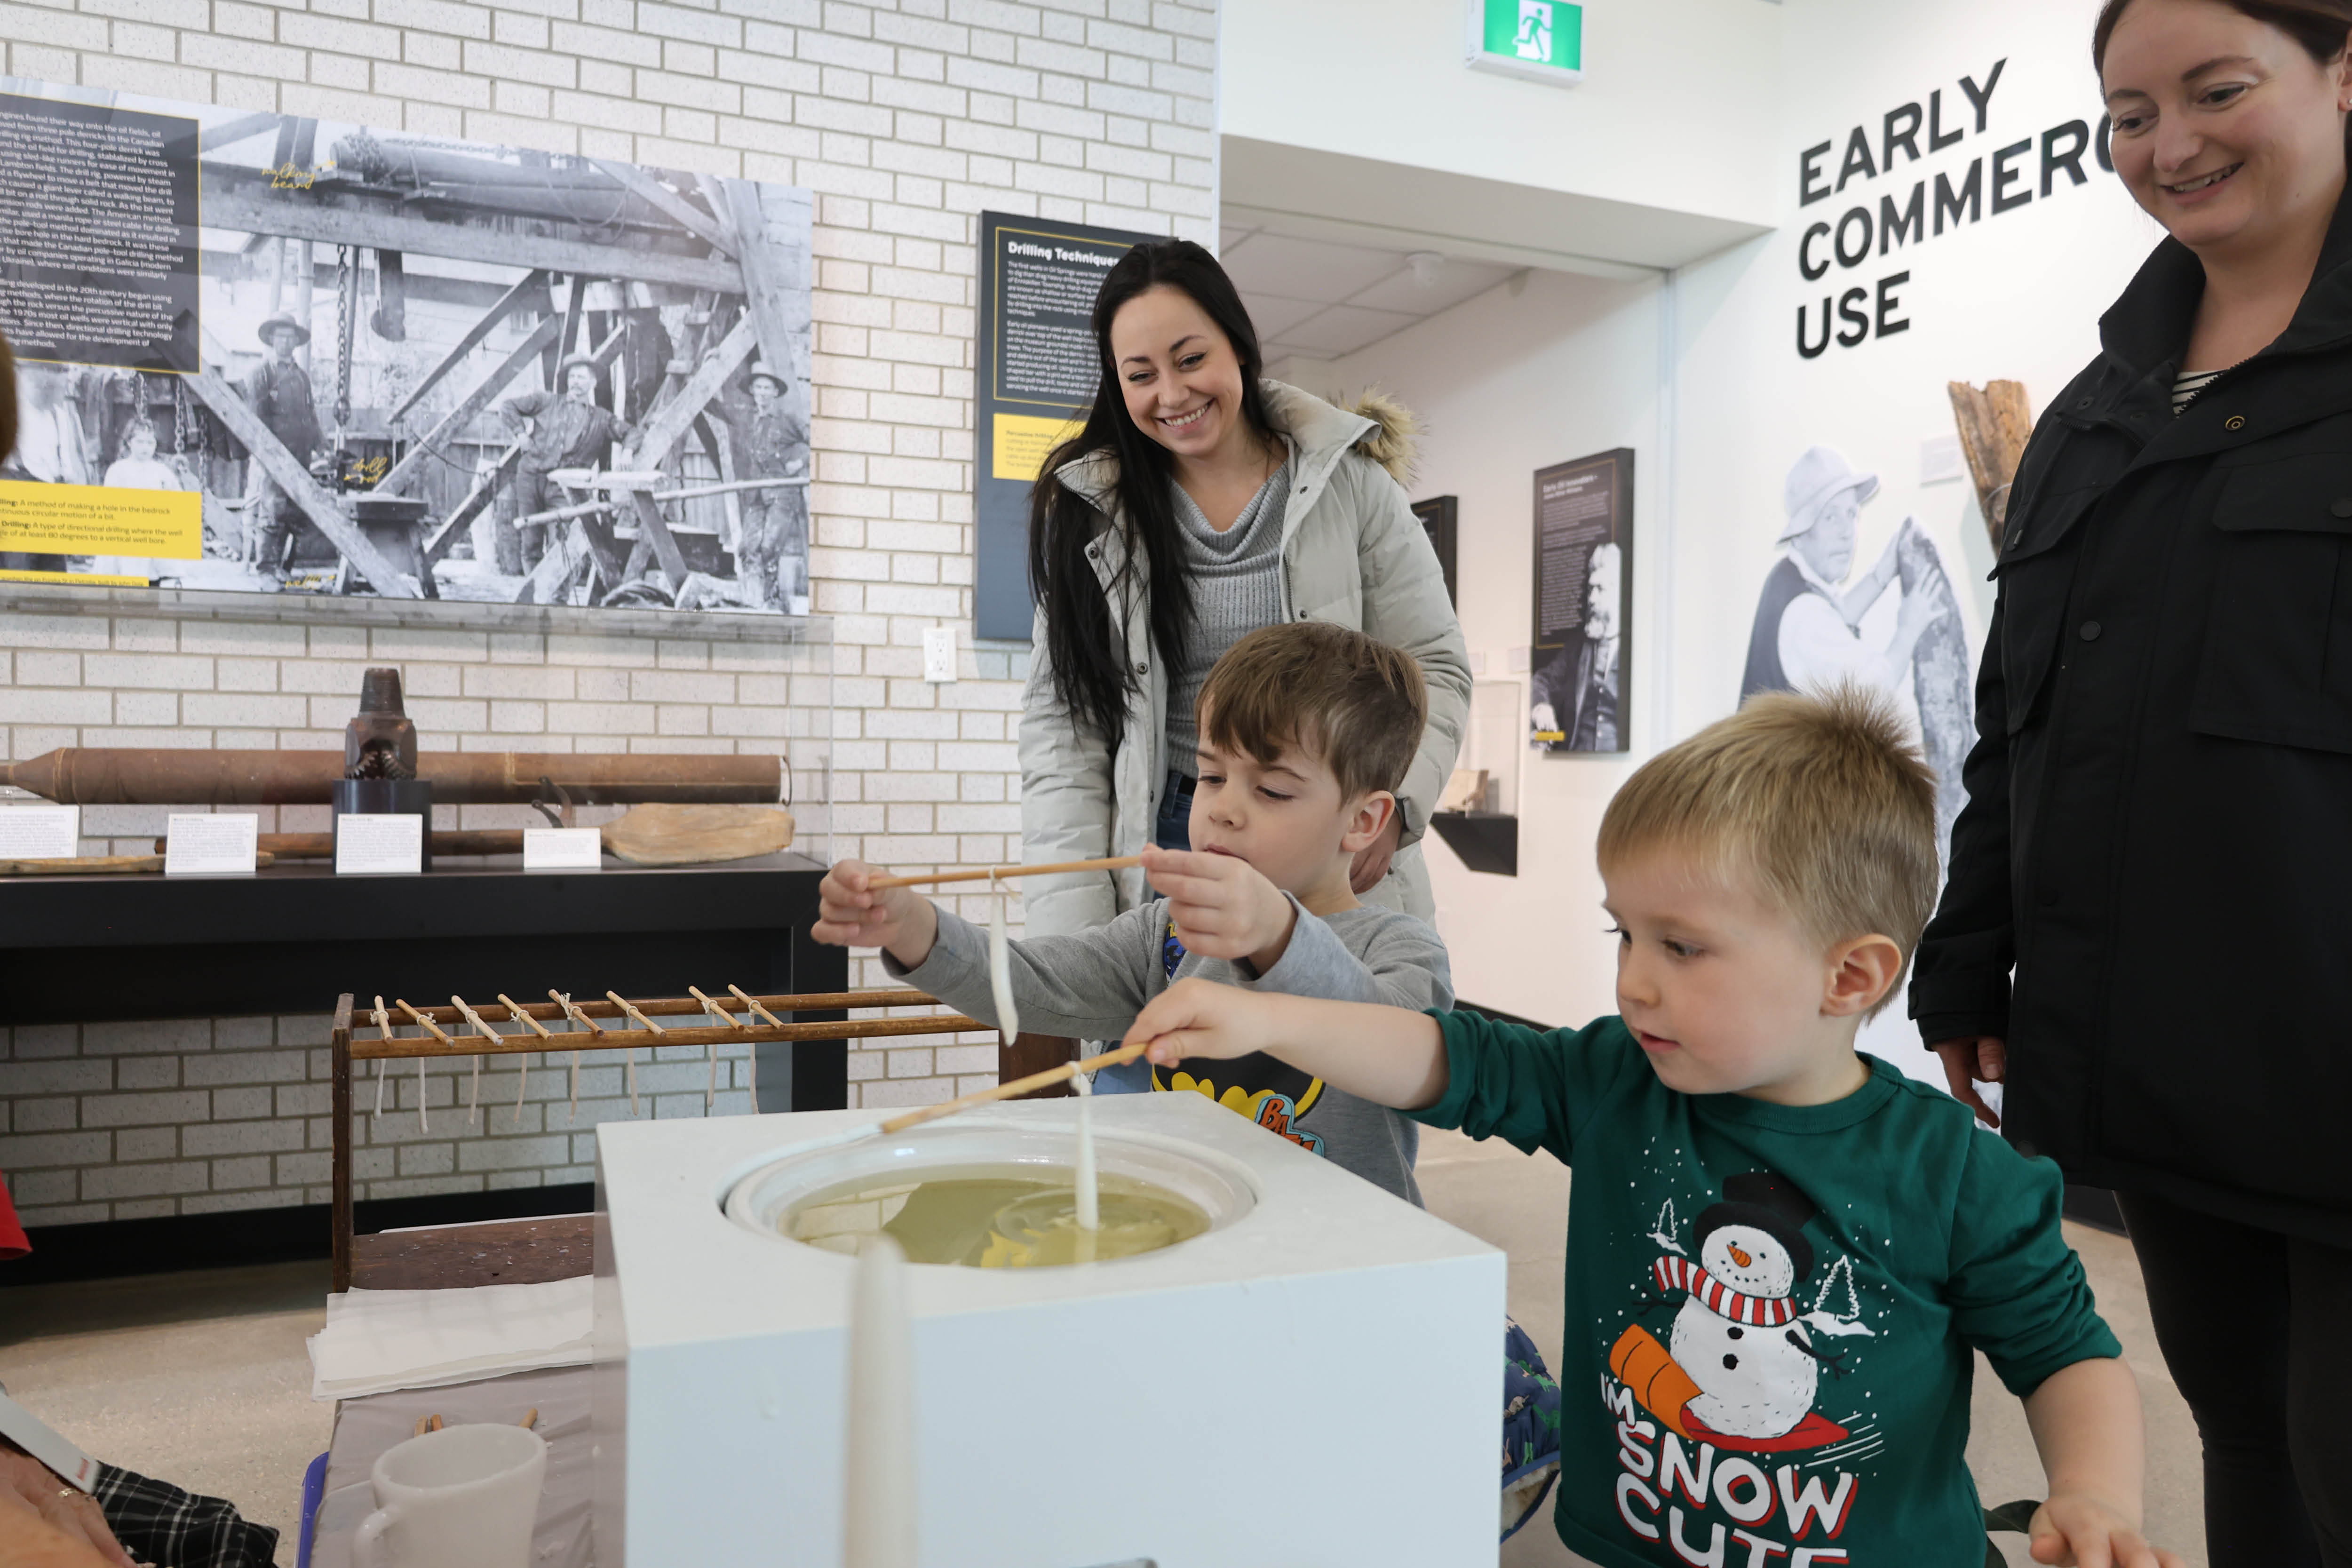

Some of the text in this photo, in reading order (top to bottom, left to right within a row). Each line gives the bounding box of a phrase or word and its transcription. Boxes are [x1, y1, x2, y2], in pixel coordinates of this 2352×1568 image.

[1800, 57, 2007, 208] EARLY
[1008, 241, 1120, 267] Drilling Techniques
[1057, 268, 1075, 276] Springs
[1796, 270, 1910, 359] USE
[352, 456, 388, 473] drill
[1600, 1371, 1636, 1426] I'M
[1616, 1420, 1856, 1537] SNOW
